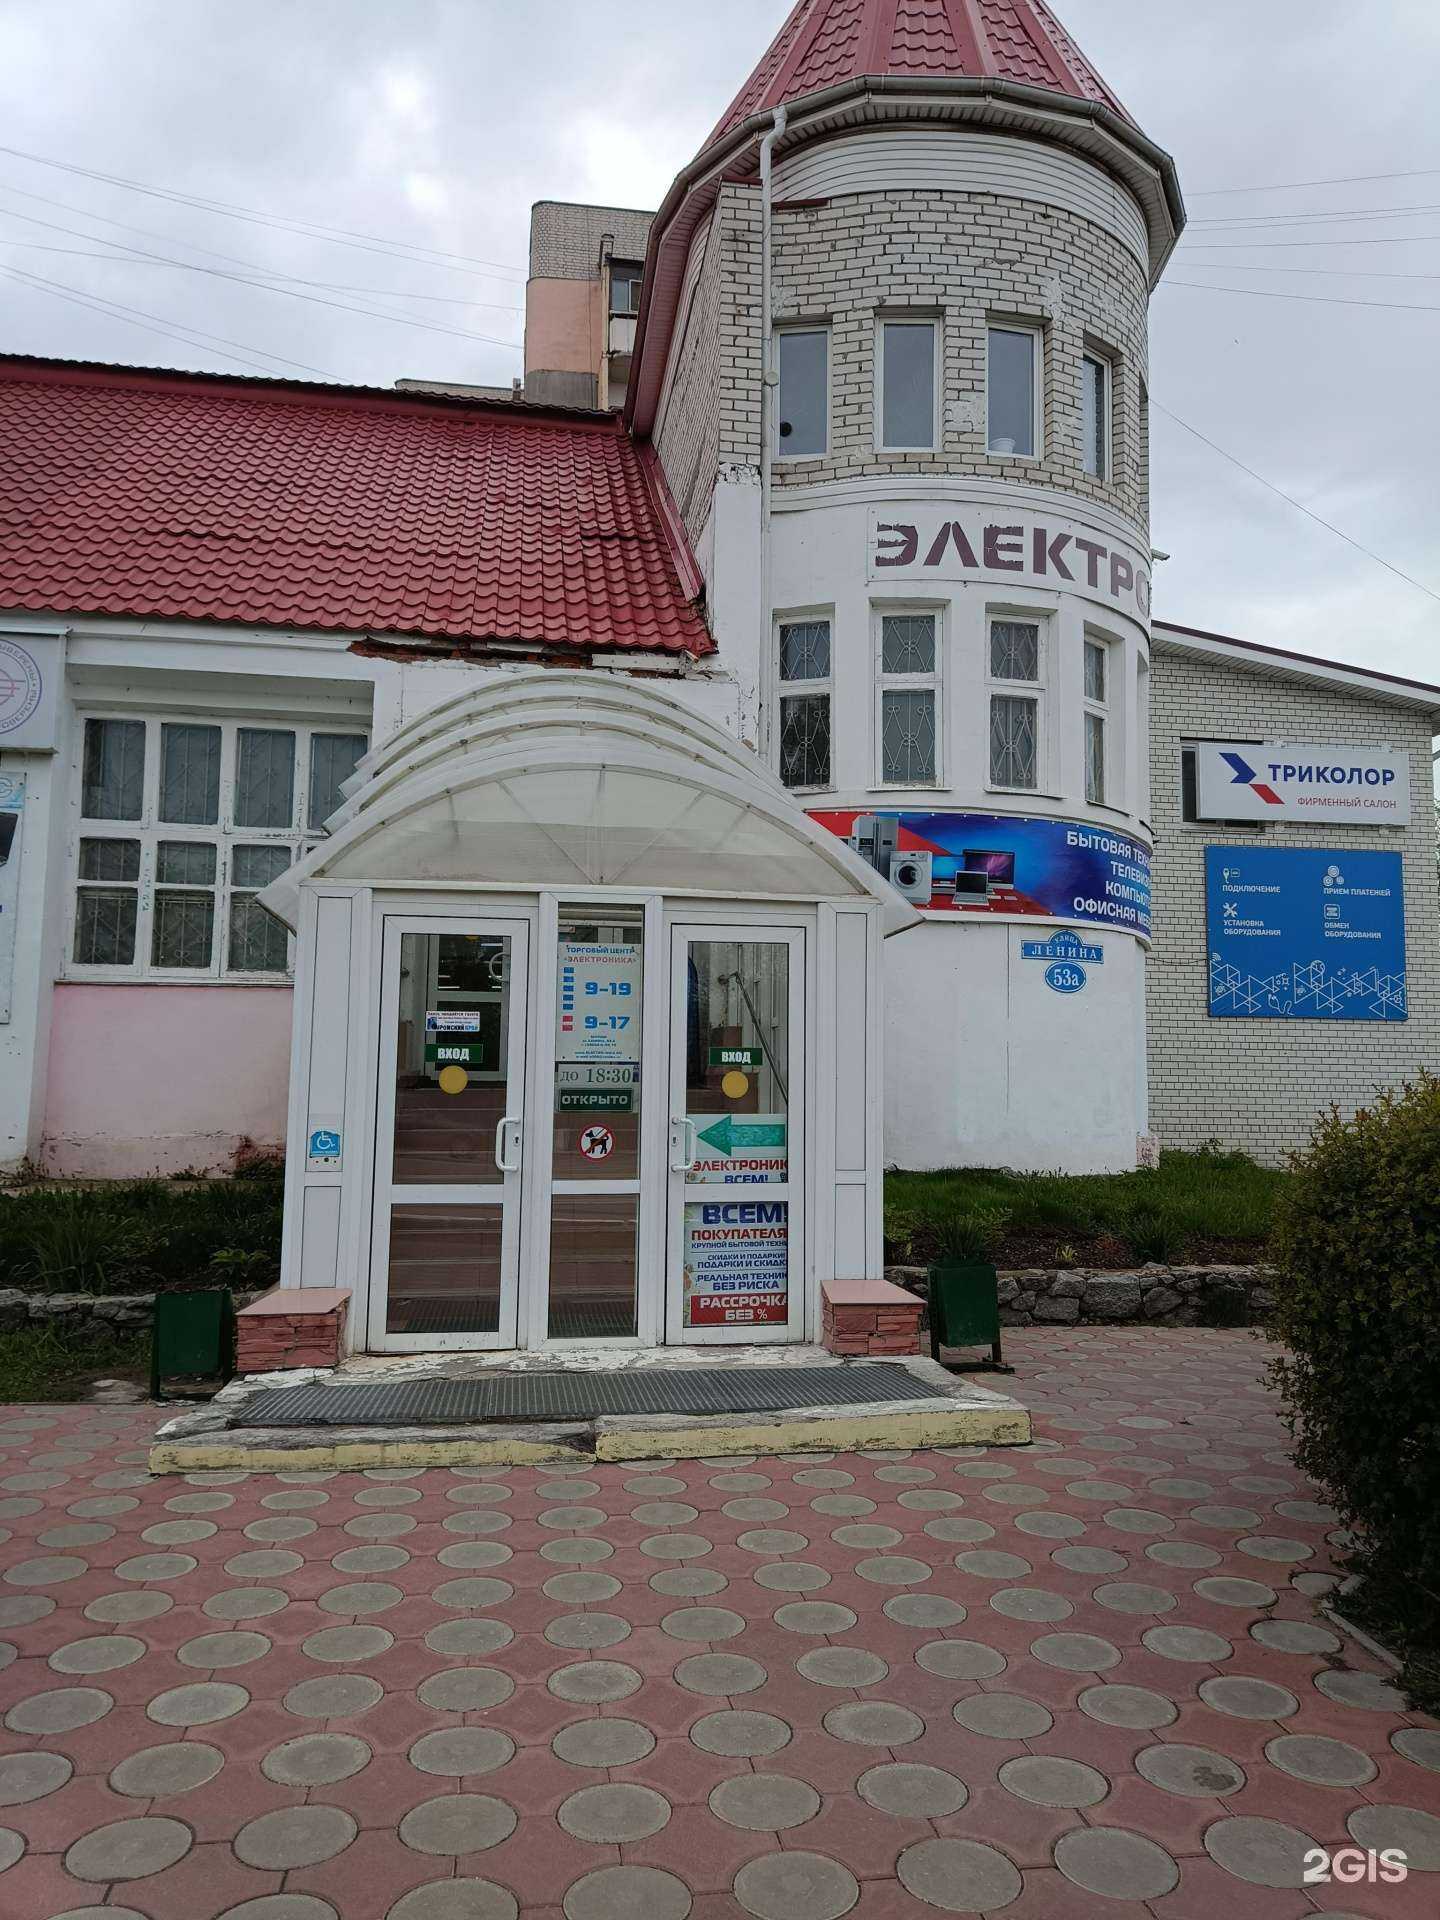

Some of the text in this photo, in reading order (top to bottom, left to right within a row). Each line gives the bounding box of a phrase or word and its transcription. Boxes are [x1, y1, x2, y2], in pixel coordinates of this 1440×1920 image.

[1268, 764, 1395, 786] ТРИКОЛОР
[1297, 796, 1396, 809] ФИРМЕННЫЙ САЛОН
[1066, 831, 1131, 858] БЫТОВАЯ
[1222, 885, 1281, 893] ПОДКЛЮЧЕНИЕ
[1323, 887, 1391, 897] ПРИЕМ ПЛАТЕЖЕЙ
[1073, 896, 1136, 922] ОФИСНАЯ
[1223, 919, 1265, 927] УСТАНОВКА
[1223, 928, 1281, 937] ОБОРУДОВАНИЯ
[1324, 930, 1382, 939] ОБОРУДОВАНИЯ
[567, 946, 609, 954] ТОРГОВЫЙ
[1031, 944, 1097, 960] ЛЕНИНА
[1053, 968, 1080, 987] 53а
[437, 1048, 470, 1061] ВХОД
[721, 1051, 751, 1064] ВХОД
[560, 1067, 631, 1083] ДО 18:30
[561, 1095, 628, 1105] ОТКРЫТО
[728, 1240, 765, 1248] БЫТОВОЙ
[697, 1261, 743, 1269] ПОДАРКИ
[745, 1260, 752, 1268] И
[697, 1273, 748, 1282] РЕАЛЬНАЯ
[712, 1281, 779, 1291] БЕЗ РИСКА
[725, 1308, 768, 1320] БЕЗ %
